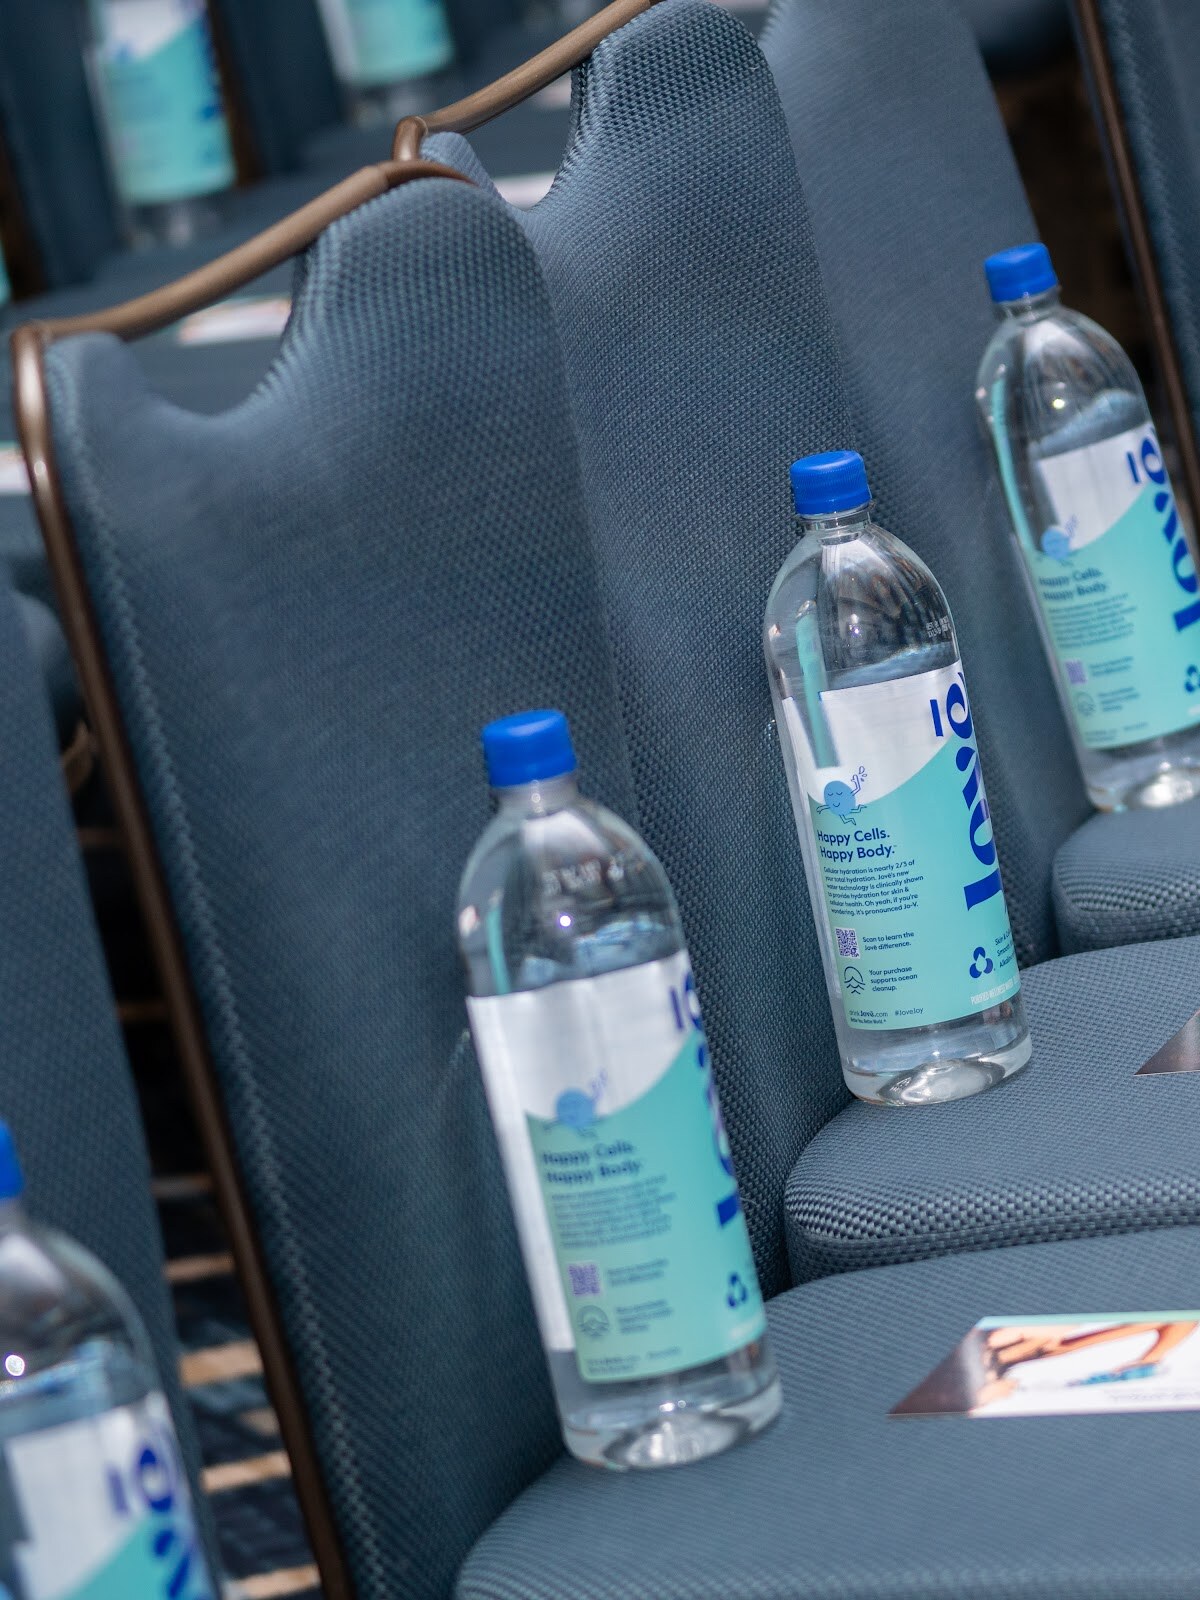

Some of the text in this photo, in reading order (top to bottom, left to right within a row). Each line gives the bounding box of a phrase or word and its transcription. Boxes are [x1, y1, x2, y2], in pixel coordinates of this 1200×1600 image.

[817, 828, 890, 846] Happy Cells.
[820, 846, 853, 862] Happy
[840, 866, 867, 875] hydration
[874, 864, 894, 873] nearly
[895, 861, 907, 869] 2/3
[838, 883, 869, 892] technology
[875, 880, 902, 889] clinically
[904, 875, 924, 884] shown
[832, 891, 850, 899] provide
[851, 891, 879, 900] hydration
[875, 898, 893, 907] yeah,
[899, 893, 918, 903] you're
[856, 907, 865, 915] it's
[865, 905, 903, 916] pronounced
[878, 941, 912, 950] difference.
[883, 966, 912, 976] purchase
[870, 976, 897, 984] supports
[872, 985, 897, 993] cleanup.
